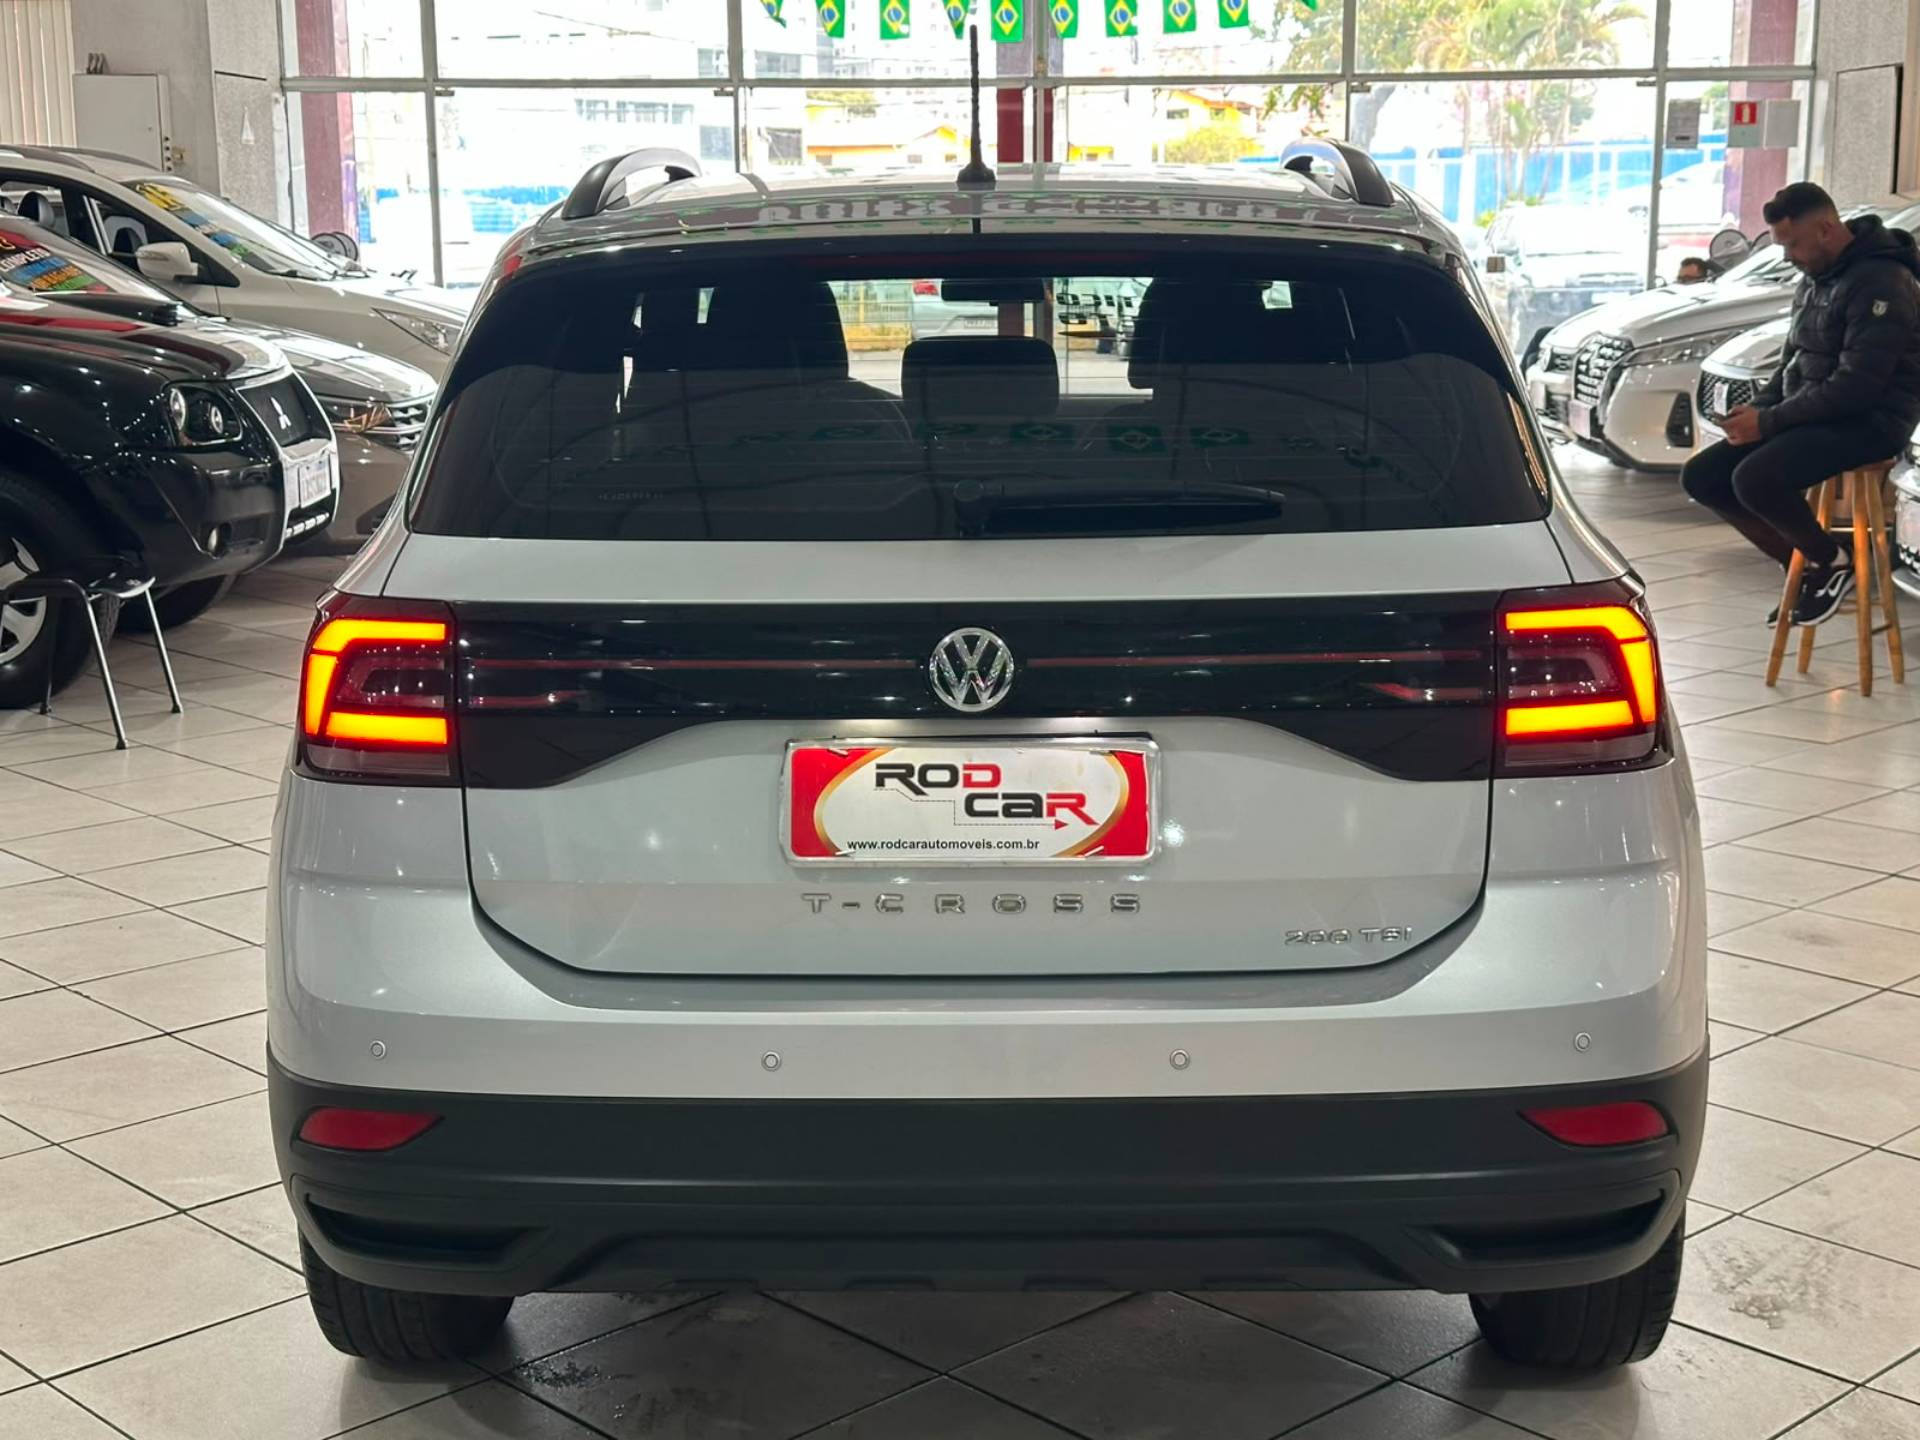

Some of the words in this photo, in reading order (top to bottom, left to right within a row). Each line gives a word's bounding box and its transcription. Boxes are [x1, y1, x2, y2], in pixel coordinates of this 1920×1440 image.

[875, 763, 1001, 796] ROD
[847, 838, 1040, 850] www.rodcarautomoveis.com.br
[801, 892, 1141, 914] T-CROSS
[1284, 929, 1351, 945] 200
[1359, 926, 1413, 943] TSI
